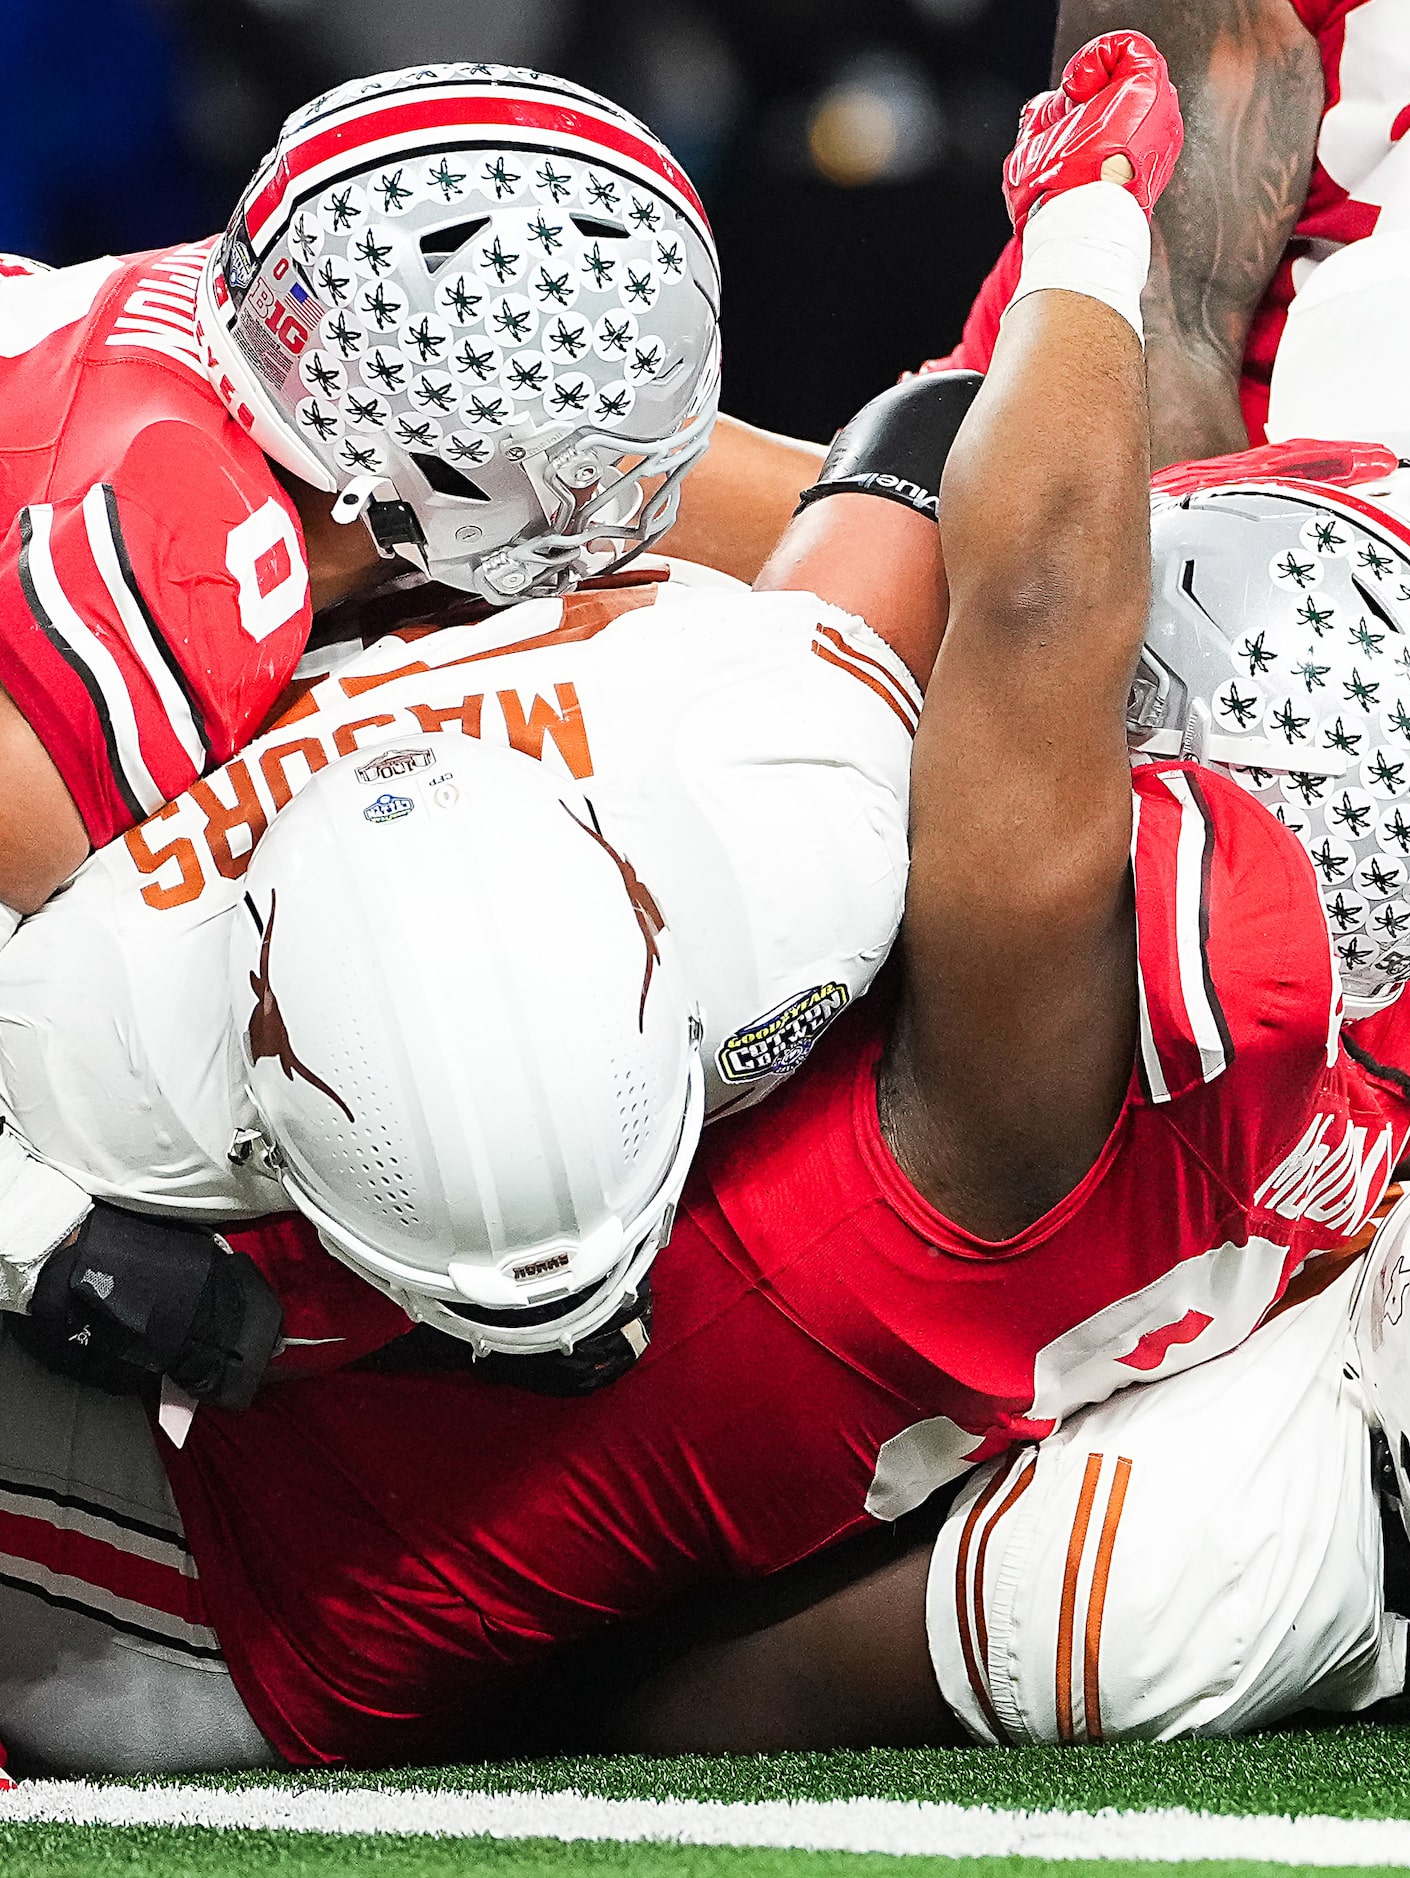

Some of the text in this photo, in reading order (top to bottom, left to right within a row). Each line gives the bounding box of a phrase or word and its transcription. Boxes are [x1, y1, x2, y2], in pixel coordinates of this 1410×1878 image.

[274, 258, 290, 281] 0
[225, 496, 309, 643] 0
[428, 772, 454, 787] CFP
[727, 984, 836, 1048] GOODYEAR
[728, 990, 841, 1072] COTTON
